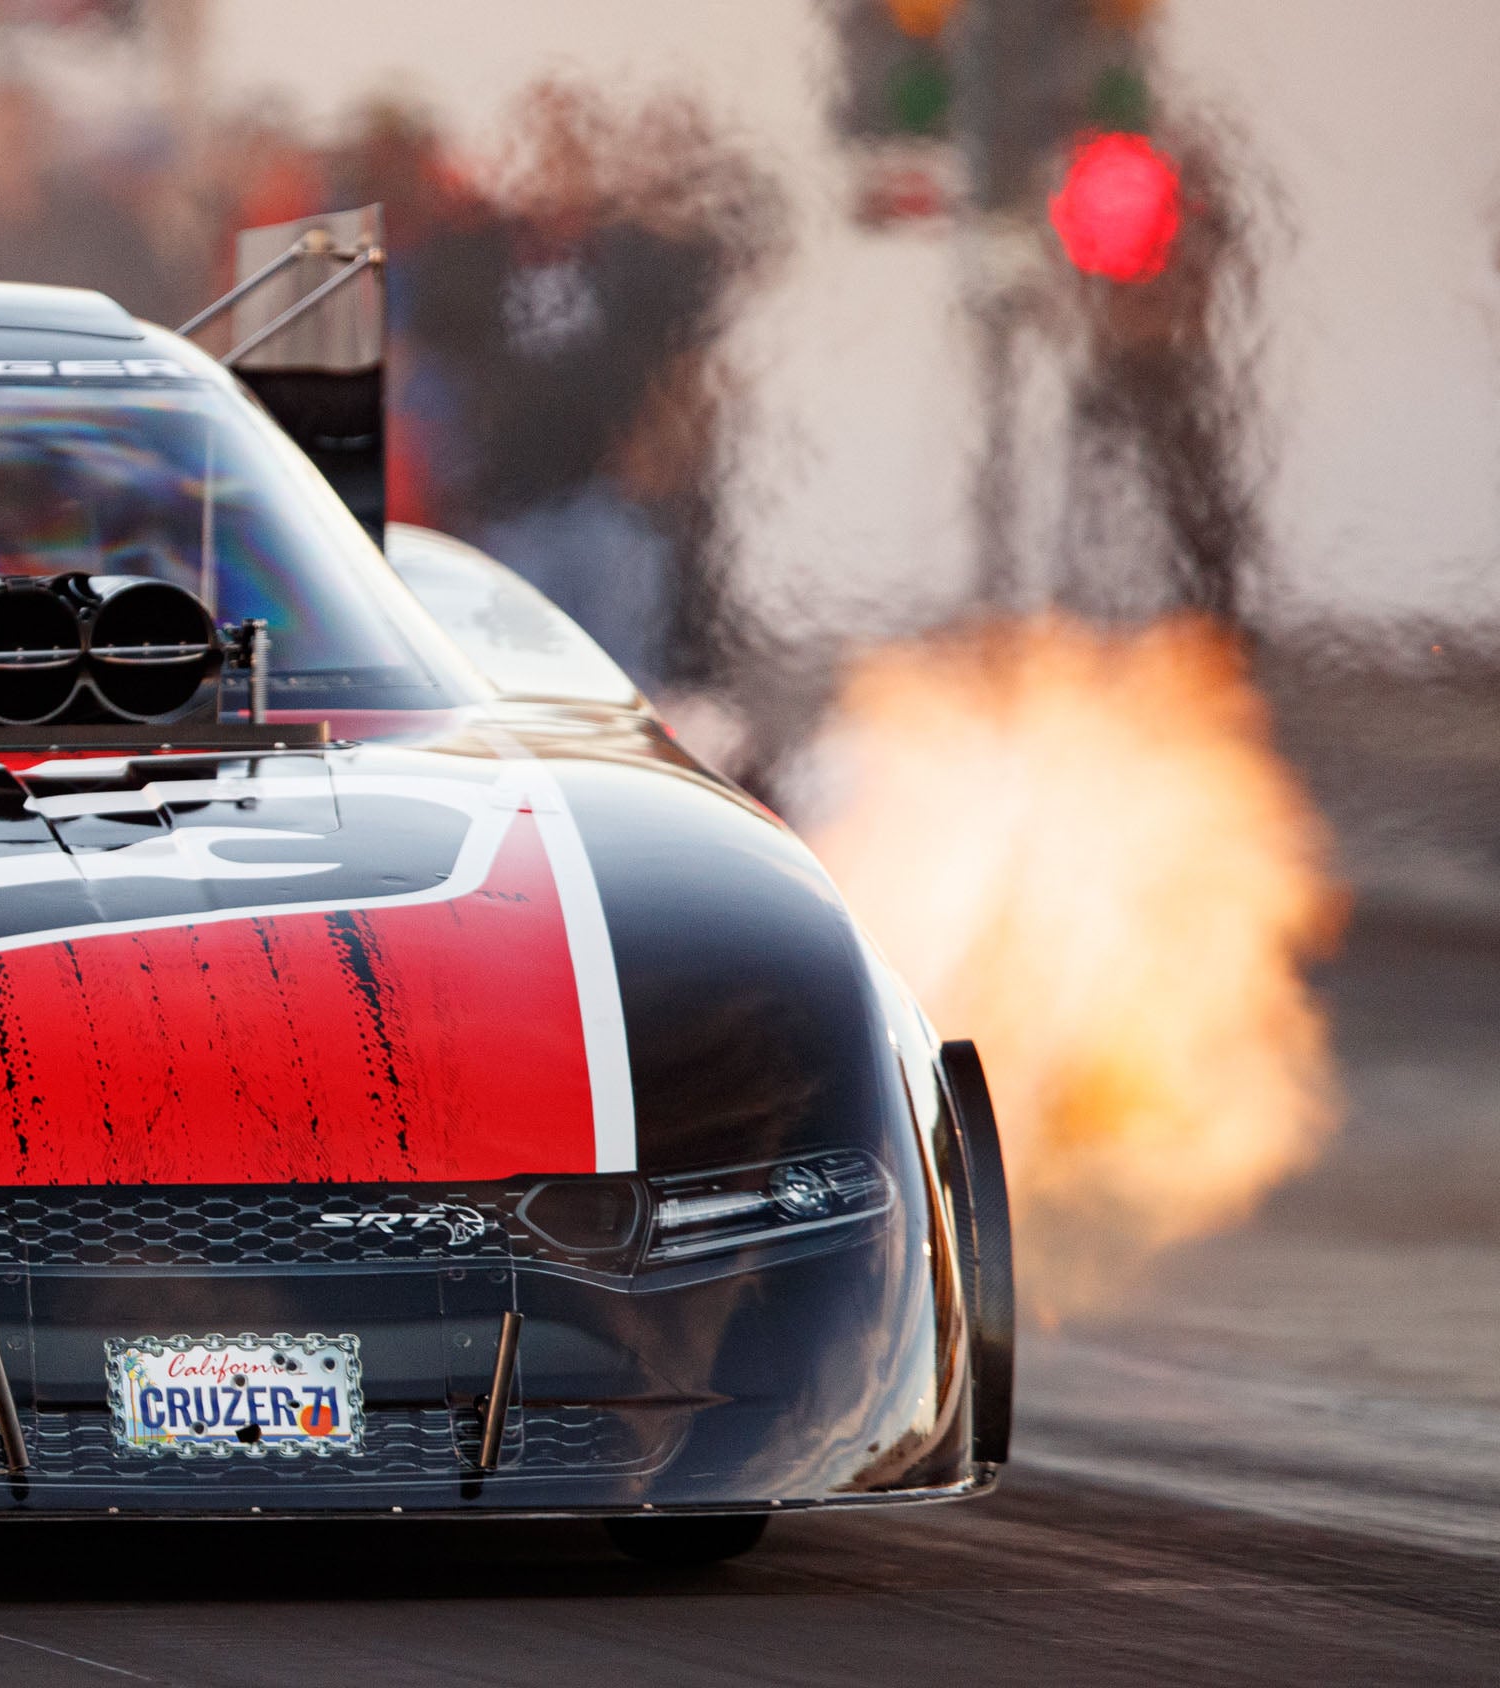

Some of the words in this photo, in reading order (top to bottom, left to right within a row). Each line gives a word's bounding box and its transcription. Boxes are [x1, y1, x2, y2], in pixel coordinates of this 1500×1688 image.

[310, 1213, 446, 1234] SRT
[139, 1386, 298, 1428] CRUZER
[301, 1385, 341, 1427] 71
